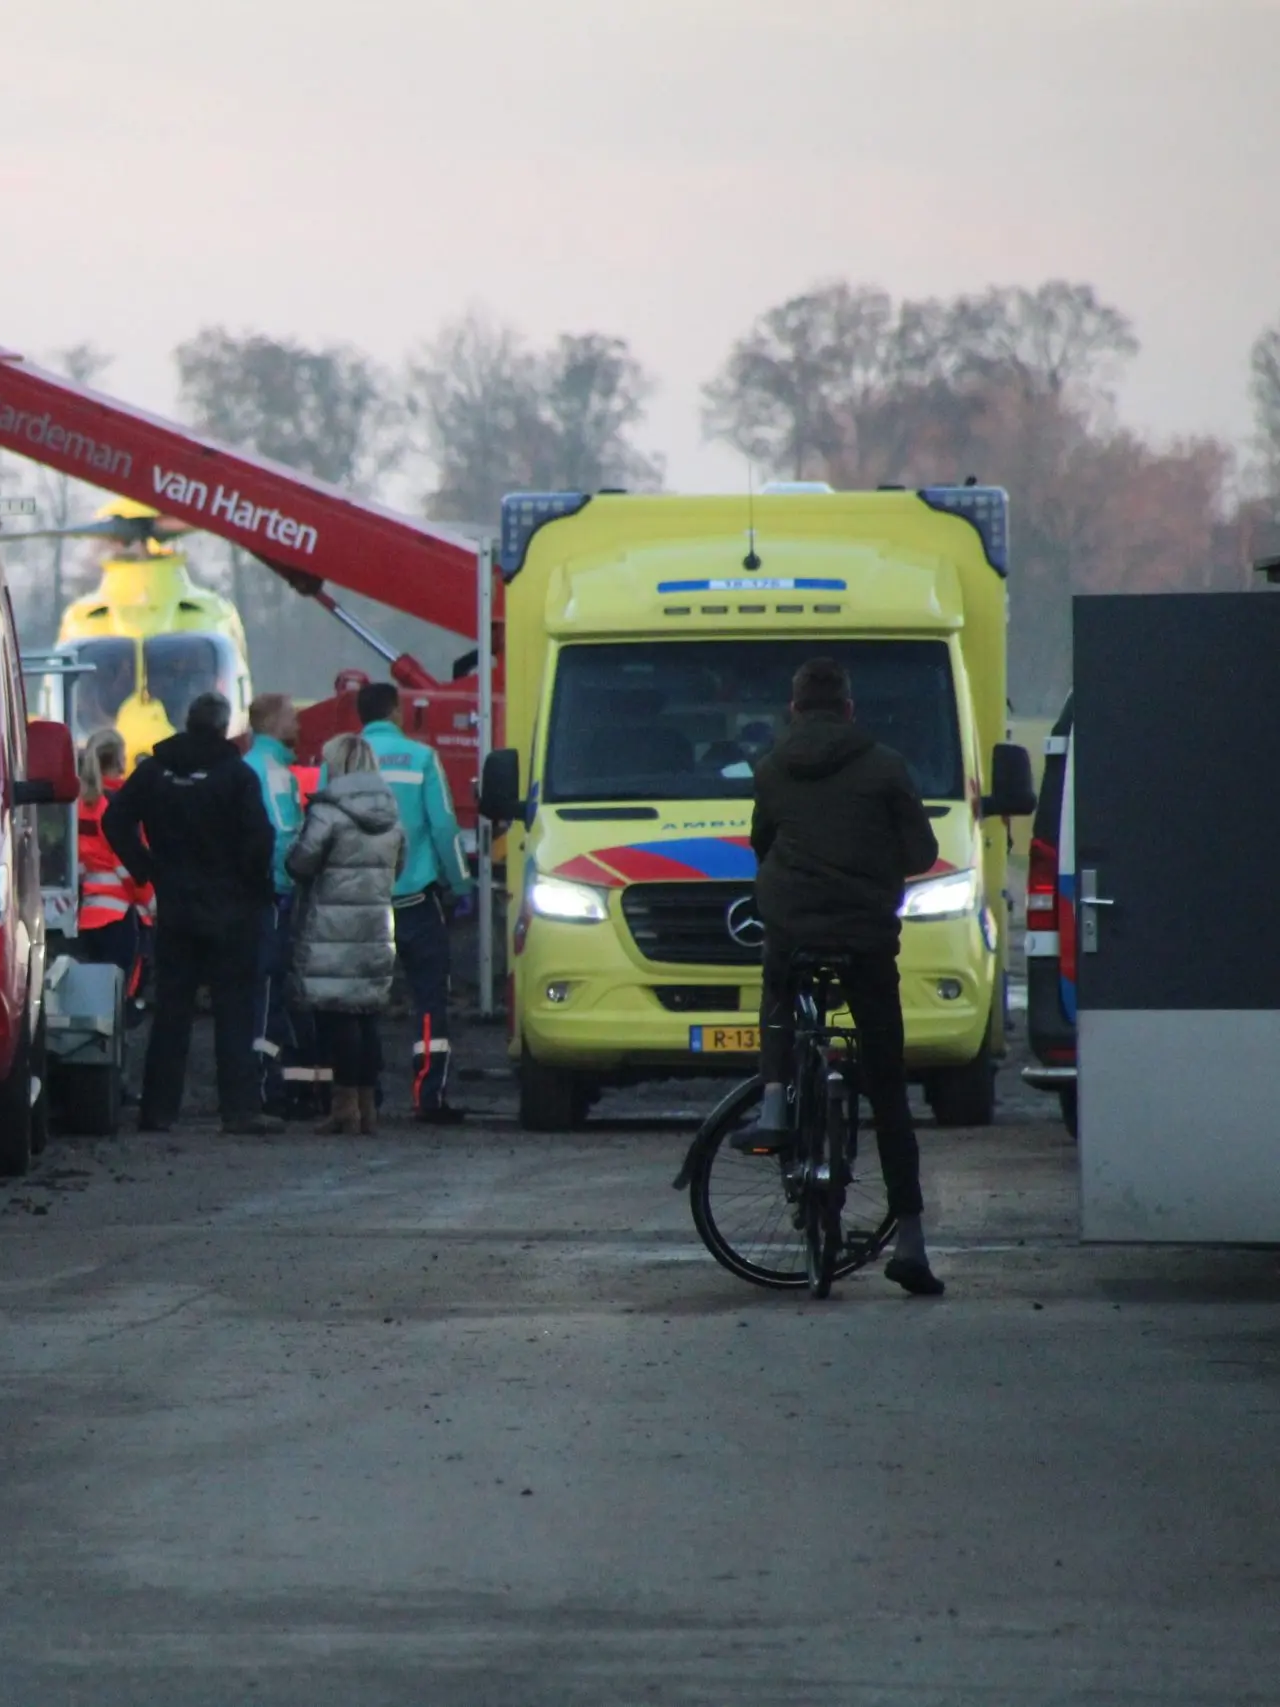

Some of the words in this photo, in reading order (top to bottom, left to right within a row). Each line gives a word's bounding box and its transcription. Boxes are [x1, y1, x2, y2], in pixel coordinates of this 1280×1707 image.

[152, 464, 208, 511] van
[210, 485, 317, 554] Harten
[714, 1030, 762, 1048] R-13
